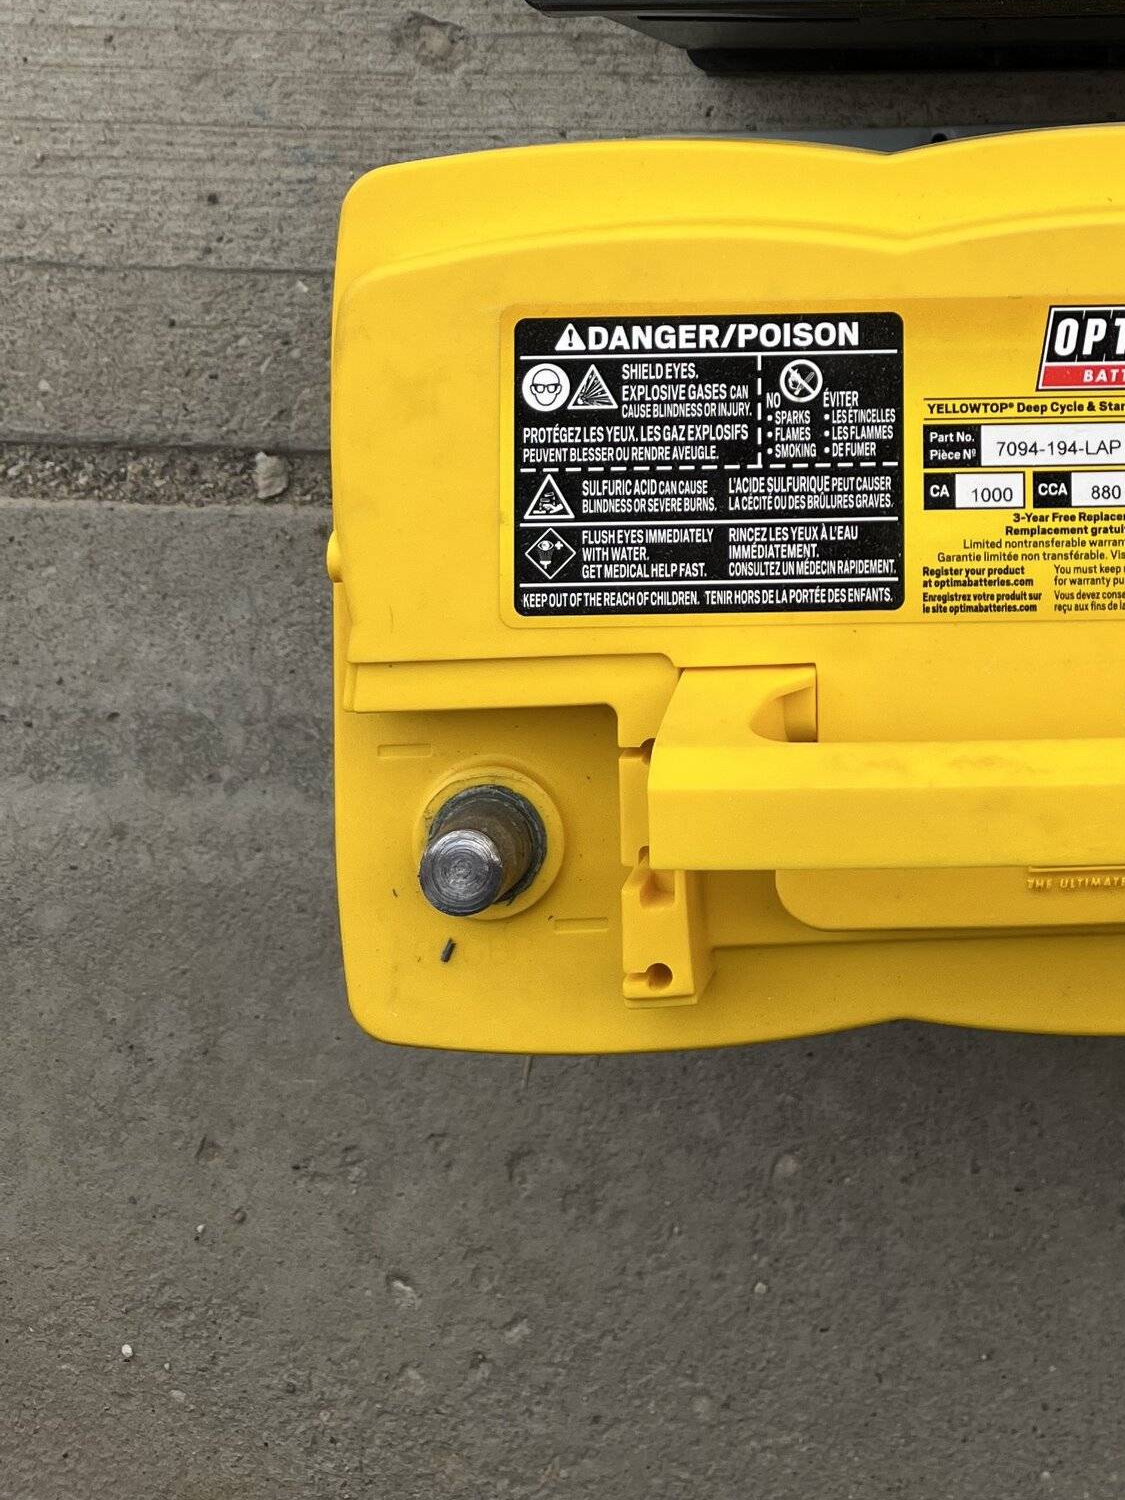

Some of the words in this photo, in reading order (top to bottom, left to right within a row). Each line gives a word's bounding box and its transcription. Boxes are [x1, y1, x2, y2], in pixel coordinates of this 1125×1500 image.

[588, 322, 859, 350] DANGER/POISON
[622, 363, 663, 380] SHIELD
[665, 363, 698, 379] EYES.
[622, 384, 686, 401] EXPLOSIVE
[688, 383, 727, 400] GASES
[1017, 402, 1048, 415] Deep
[1050, 401, 1084, 415] Cycle
[1087, 401, 1096, 412] &
[775, 410, 810, 425] SPARKS
[775, 427, 811, 441] FLAMES
[775, 443, 816, 458] SMOKING
[997, 439, 1121, 456] 7094-194-LAP
[582, 479, 632, 496] SULFURIC
[633, 479, 657, 495] ACID
[930, 484, 950, 497] CA
[972, 487, 1013, 502] 1000
[1038, 483, 1068, 496] CCA
[1091, 485, 1121, 500] 880
[1013, 512, 1050, 523] 3-Year
[1052, 512, 1076, 522] Free
